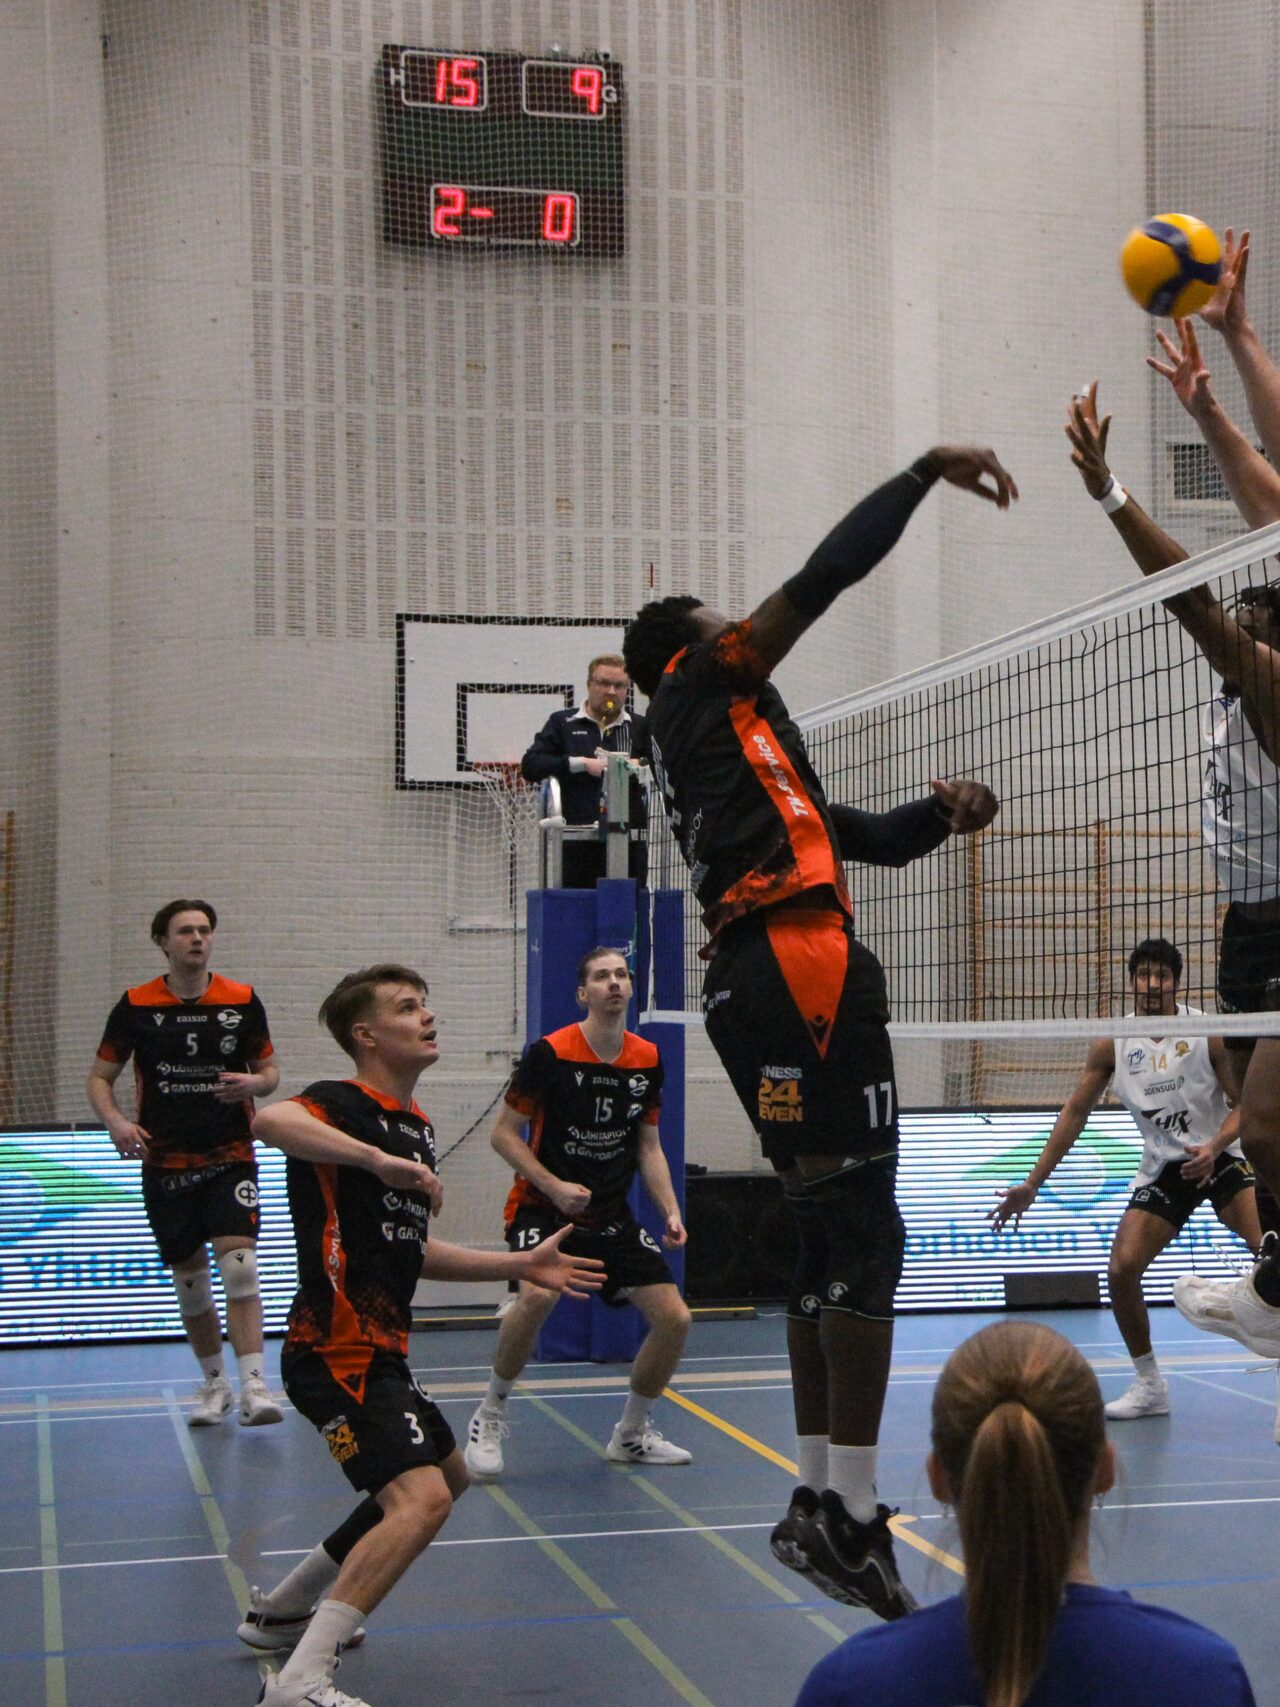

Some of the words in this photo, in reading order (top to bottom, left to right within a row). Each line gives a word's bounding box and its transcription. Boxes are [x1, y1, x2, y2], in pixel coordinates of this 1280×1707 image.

[434, 58, 479, 107] 15
[571, 67, 602, 114] 9
[186, 1033, 198, 1056] 5
[1150, 1053, 1168, 1073] 14
[758, 1077, 803, 1104] 24
[1143, 1082, 1176, 1096] JOENSUU
[595, 1096, 613, 1123] 15
[864, 1081, 892, 1128] 17
[518, 1228, 540, 1248] 15
[902, 1219, 1078, 1255] orhonen
[404, 1412, 425, 1444] 3
